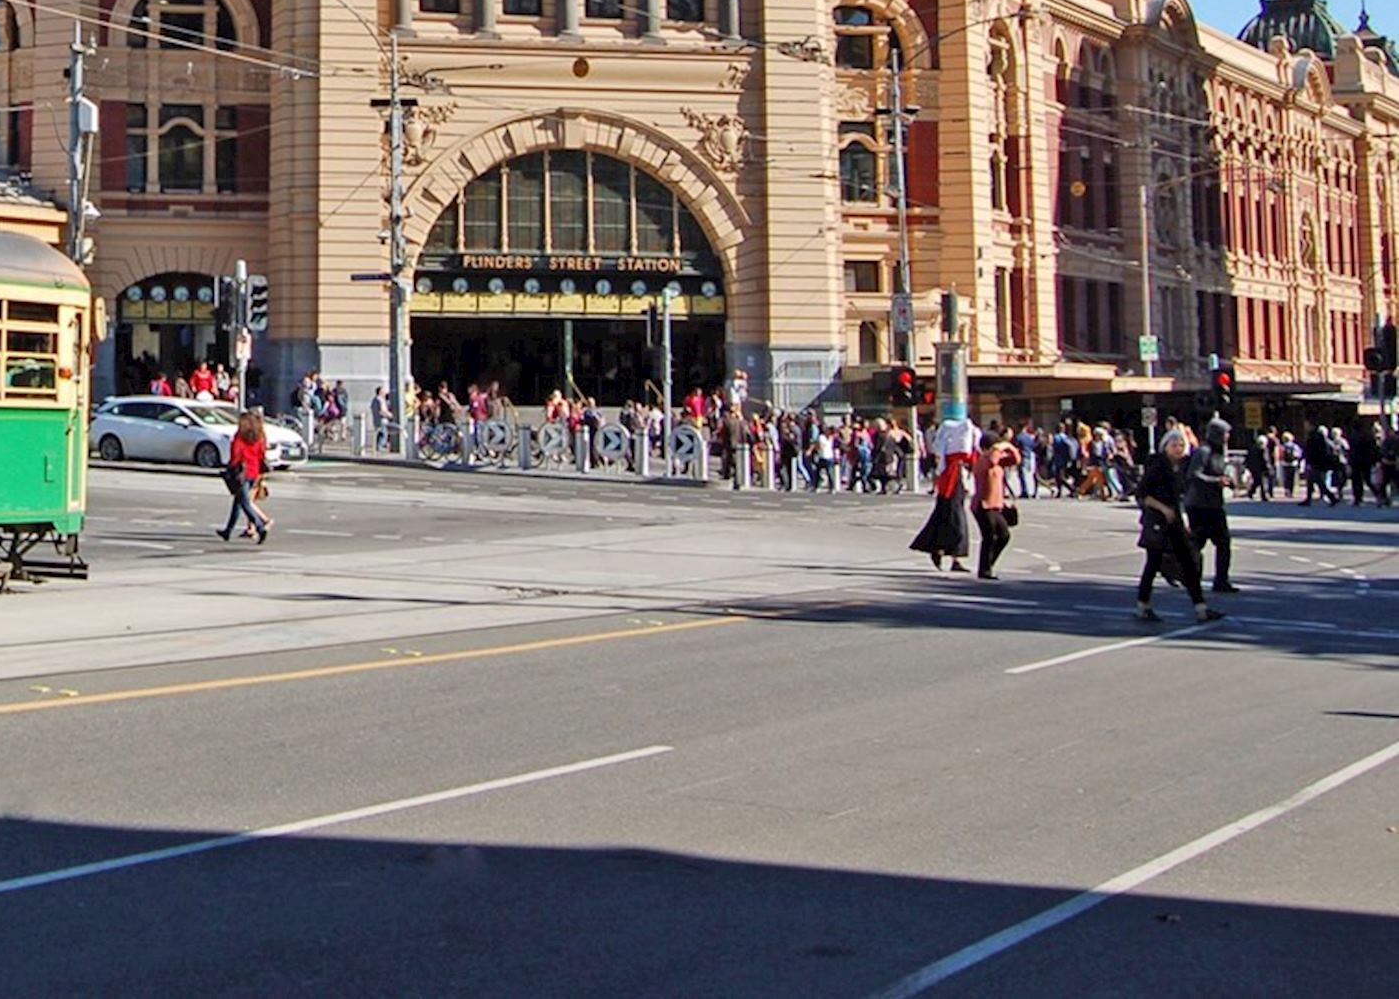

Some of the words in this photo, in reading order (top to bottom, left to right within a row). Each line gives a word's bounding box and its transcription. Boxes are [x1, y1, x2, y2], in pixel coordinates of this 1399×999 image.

[463, 255, 533, 269] FLINDERS
[549, 256, 601, 271] STREET
[617, 258, 681, 272] STATION
